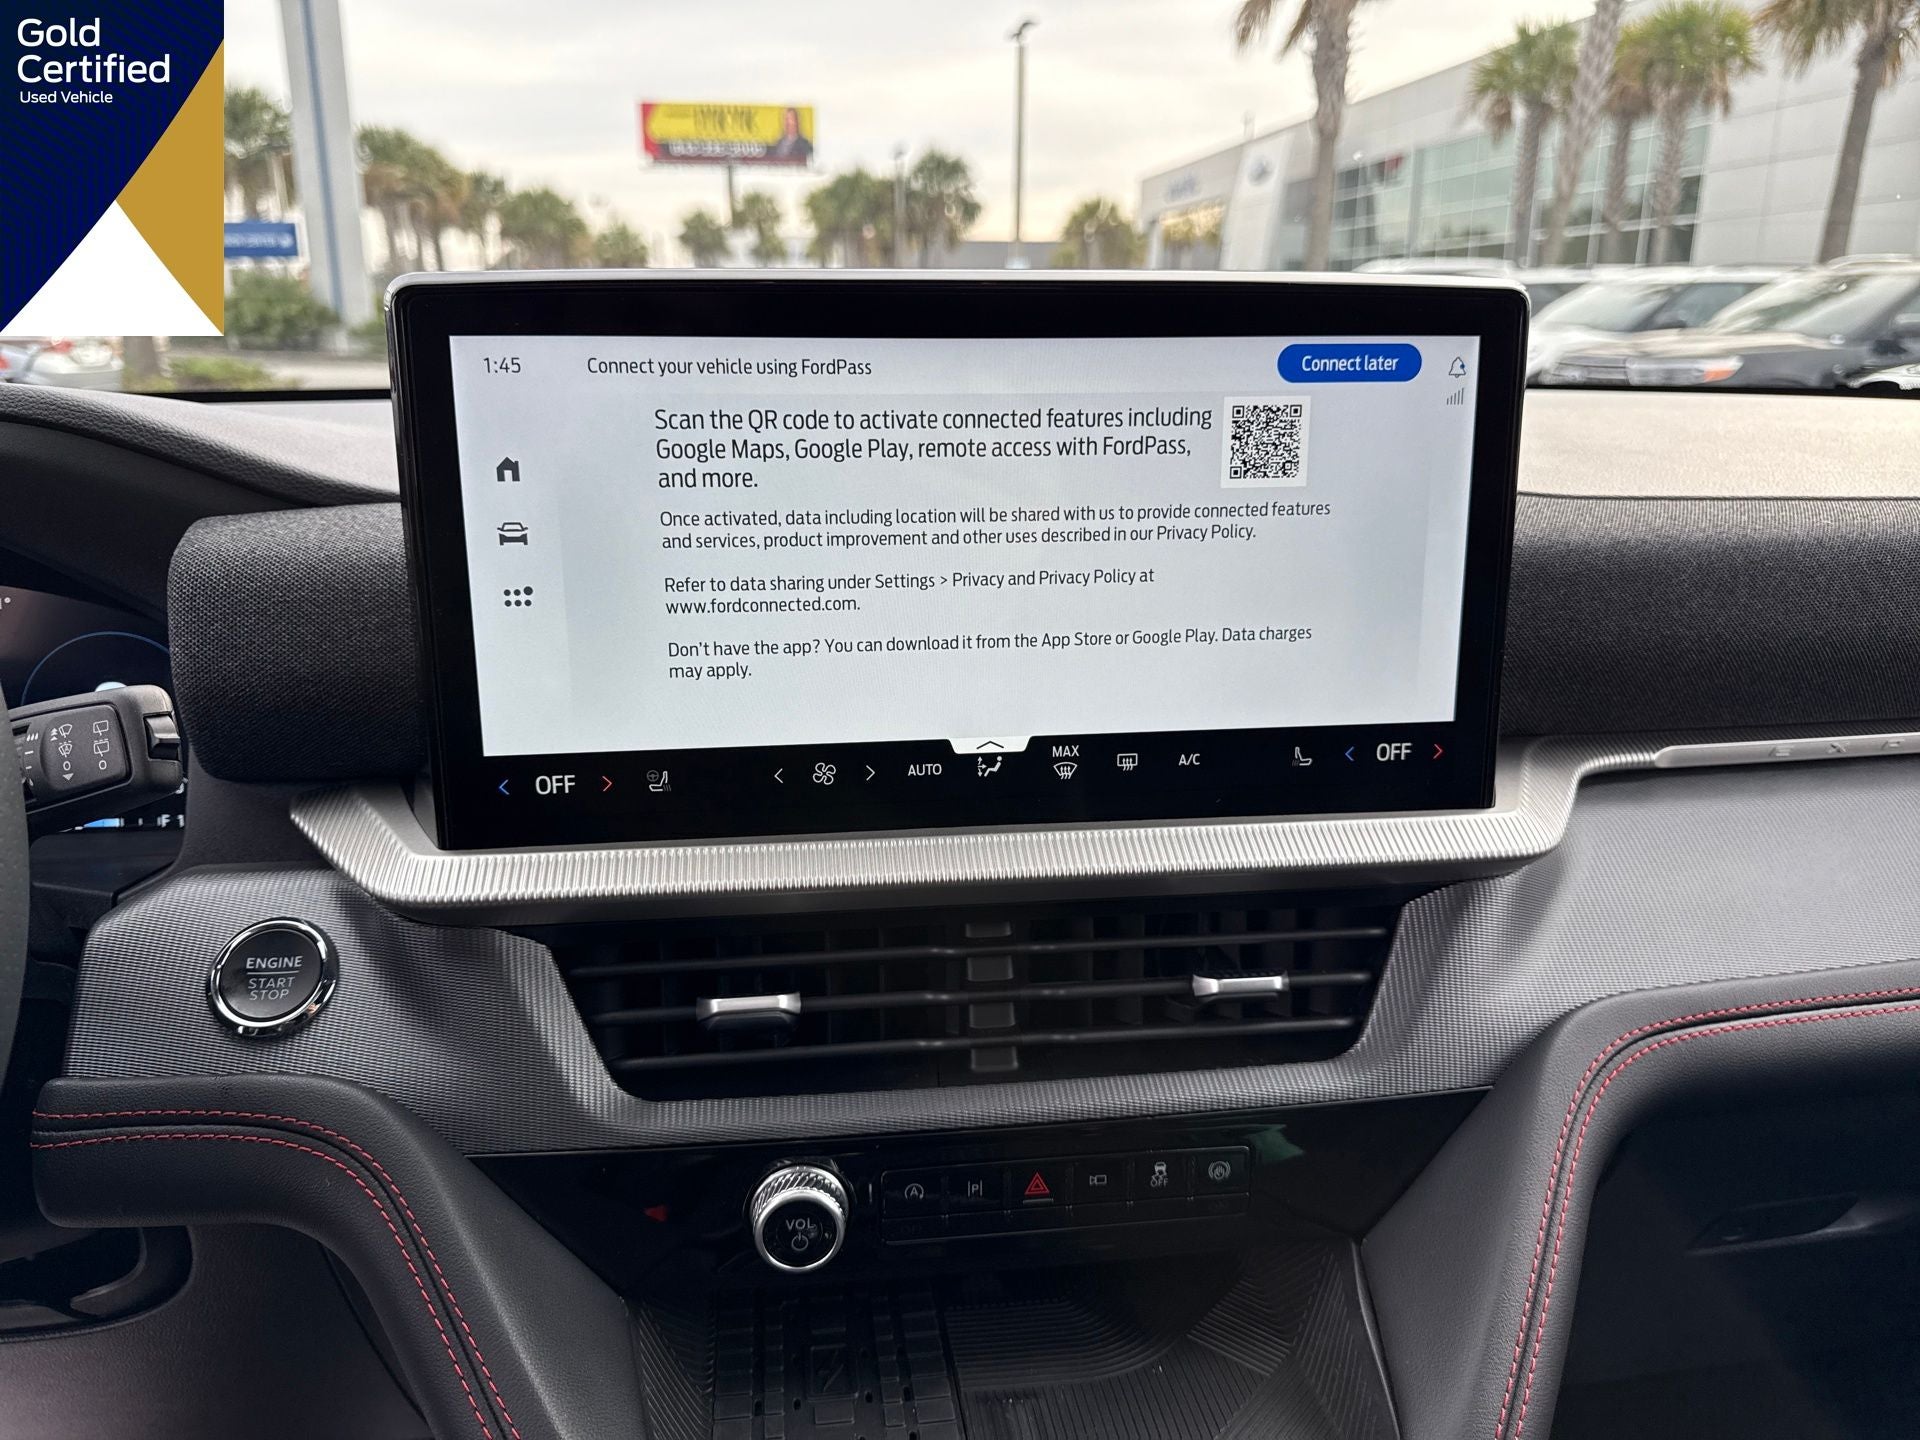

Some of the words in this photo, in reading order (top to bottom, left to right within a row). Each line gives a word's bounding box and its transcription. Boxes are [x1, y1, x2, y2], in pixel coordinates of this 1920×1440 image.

[482, 356, 522, 374] 1:45
[587, 357, 655, 375] Connect
[657, 360, 694, 378] your
[695, 357, 753, 375] vehicle
[756, 357, 799, 379] using
[801, 357, 872, 376] FordPass
[1301, 354, 1363, 372] Connect
[1363, 354, 1400, 371] later
[654, 408, 705, 433] Scan
[708, 408, 744, 431] the
[747, 408, 778, 434] QR
[782, 408, 830, 431] code
[833, 409, 855, 430] to
[859, 409, 939, 430] activate
[942, 407, 1042, 430] connected
[1045, 407, 1124, 429] features
[1128, 405, 1213, 431] including
[655, 437, 727, 464] Google
[731, 438, 790, 463] Maps,
[794, 437, 863, 463] Google
[867, 437, 914, 463] Play,
[918, 437, 987, 459] remote
[991, 440, 1052, 458] access
[1055, 435, 1098, 457] with
[1102, 434, 1192, 457] FordPass,
[658, 467, 697, 489] and
[701, 471, 759, 489] more.
[659, 510, 701, 527] Once
[703, 509, 782, 528] activated,
[785, 509, 823, 526] data
[824, 508, 893, 528] including
[895, 507, 957, 524] location
[959, 506, 986, 524] will
[989, 506, 1008, 523] be
[1010, 505, 1060, 523] shared
[1062, 504, 1096, 522] with
[1098, 508, 1115, 521] us
[1117, 505, 1135, 521] to
[1136, 503, 1191, 523] provide
[1193, 501, 1269, 519] connected
[1271, 498, 1332, 518] features
[661, 532, 693, 550] and
[695, 532, 761, 550] services,
[763, 531, 824, 552] product
[826, 530, 928, 550] improvement
[931, 528, 960, 546] and
[962, 528, 1003, 545] other
[1005, 531, 1038, 544] uses
[1040, 525, 1111, 543] described
[1113, 525, 1127, 542] in
[1129, 528, 1154, 541] our
[1156, 524, 1209, 543] Privacy
[1210, 523, 1257, 542] Policy.
[664, 575, 707, 593] Refer
[708, 576, 727, 592] to
[729, 575, 767, 592] data
[769, 574, 825, 594] sharing
[827, 573, 872, 590] under
[874, 572, 936, 591] Settings
[952, 571, 1005, 590] Privacy
[1007, 569, 1036, 586] and
[1038, 569, 1091, 588] Privacy
[1093, 567, 1137, 586] Policy
[1139, 568, 1156, 583] at
[665, 595, 861, 615] www.fordconnected.com.
[712, 640, 750, 657] have
[752, 639, 780, 656] the
[782, 638, 821, 657] app?
[823, 638, 854, 654] You
[856, 640, 883, 653] can
[885, 634, 960, 652] download
[962, 634, 973, 650] it
[975, 633, 1011, 650] from
[1013, 632, 1038, 649] the
[1040, 632, 1071, 651] App
[1073, 631, 1112, 647] Store
[1115, 633, 1131, 645] or
[1132, 628, 1182, 649] Google
[1184, 627, 1219, 646] Play.
[1221, 624, 1256, 643] Data
[1258, 623, 1313, 643] charges
[668, 665, 704, 681] may
[706, 661, 752, 681] apply.
[1052, 745, 1080, 758] MAX
[1178, 753, 1201, 767] A/C
[1376, 742, 1412, 762] OFF
[907, 763, 943, 777] AUTO
[535, 775, 576, 796] OFF
[246, 955, 303, 969] ENGINE
[248, 976, 295, 989] START
[249, 989, 289, 1001] STOP
[1150, 1175, 1169, 1188] OFF
[786, 1217, 815, 1231] VOL
